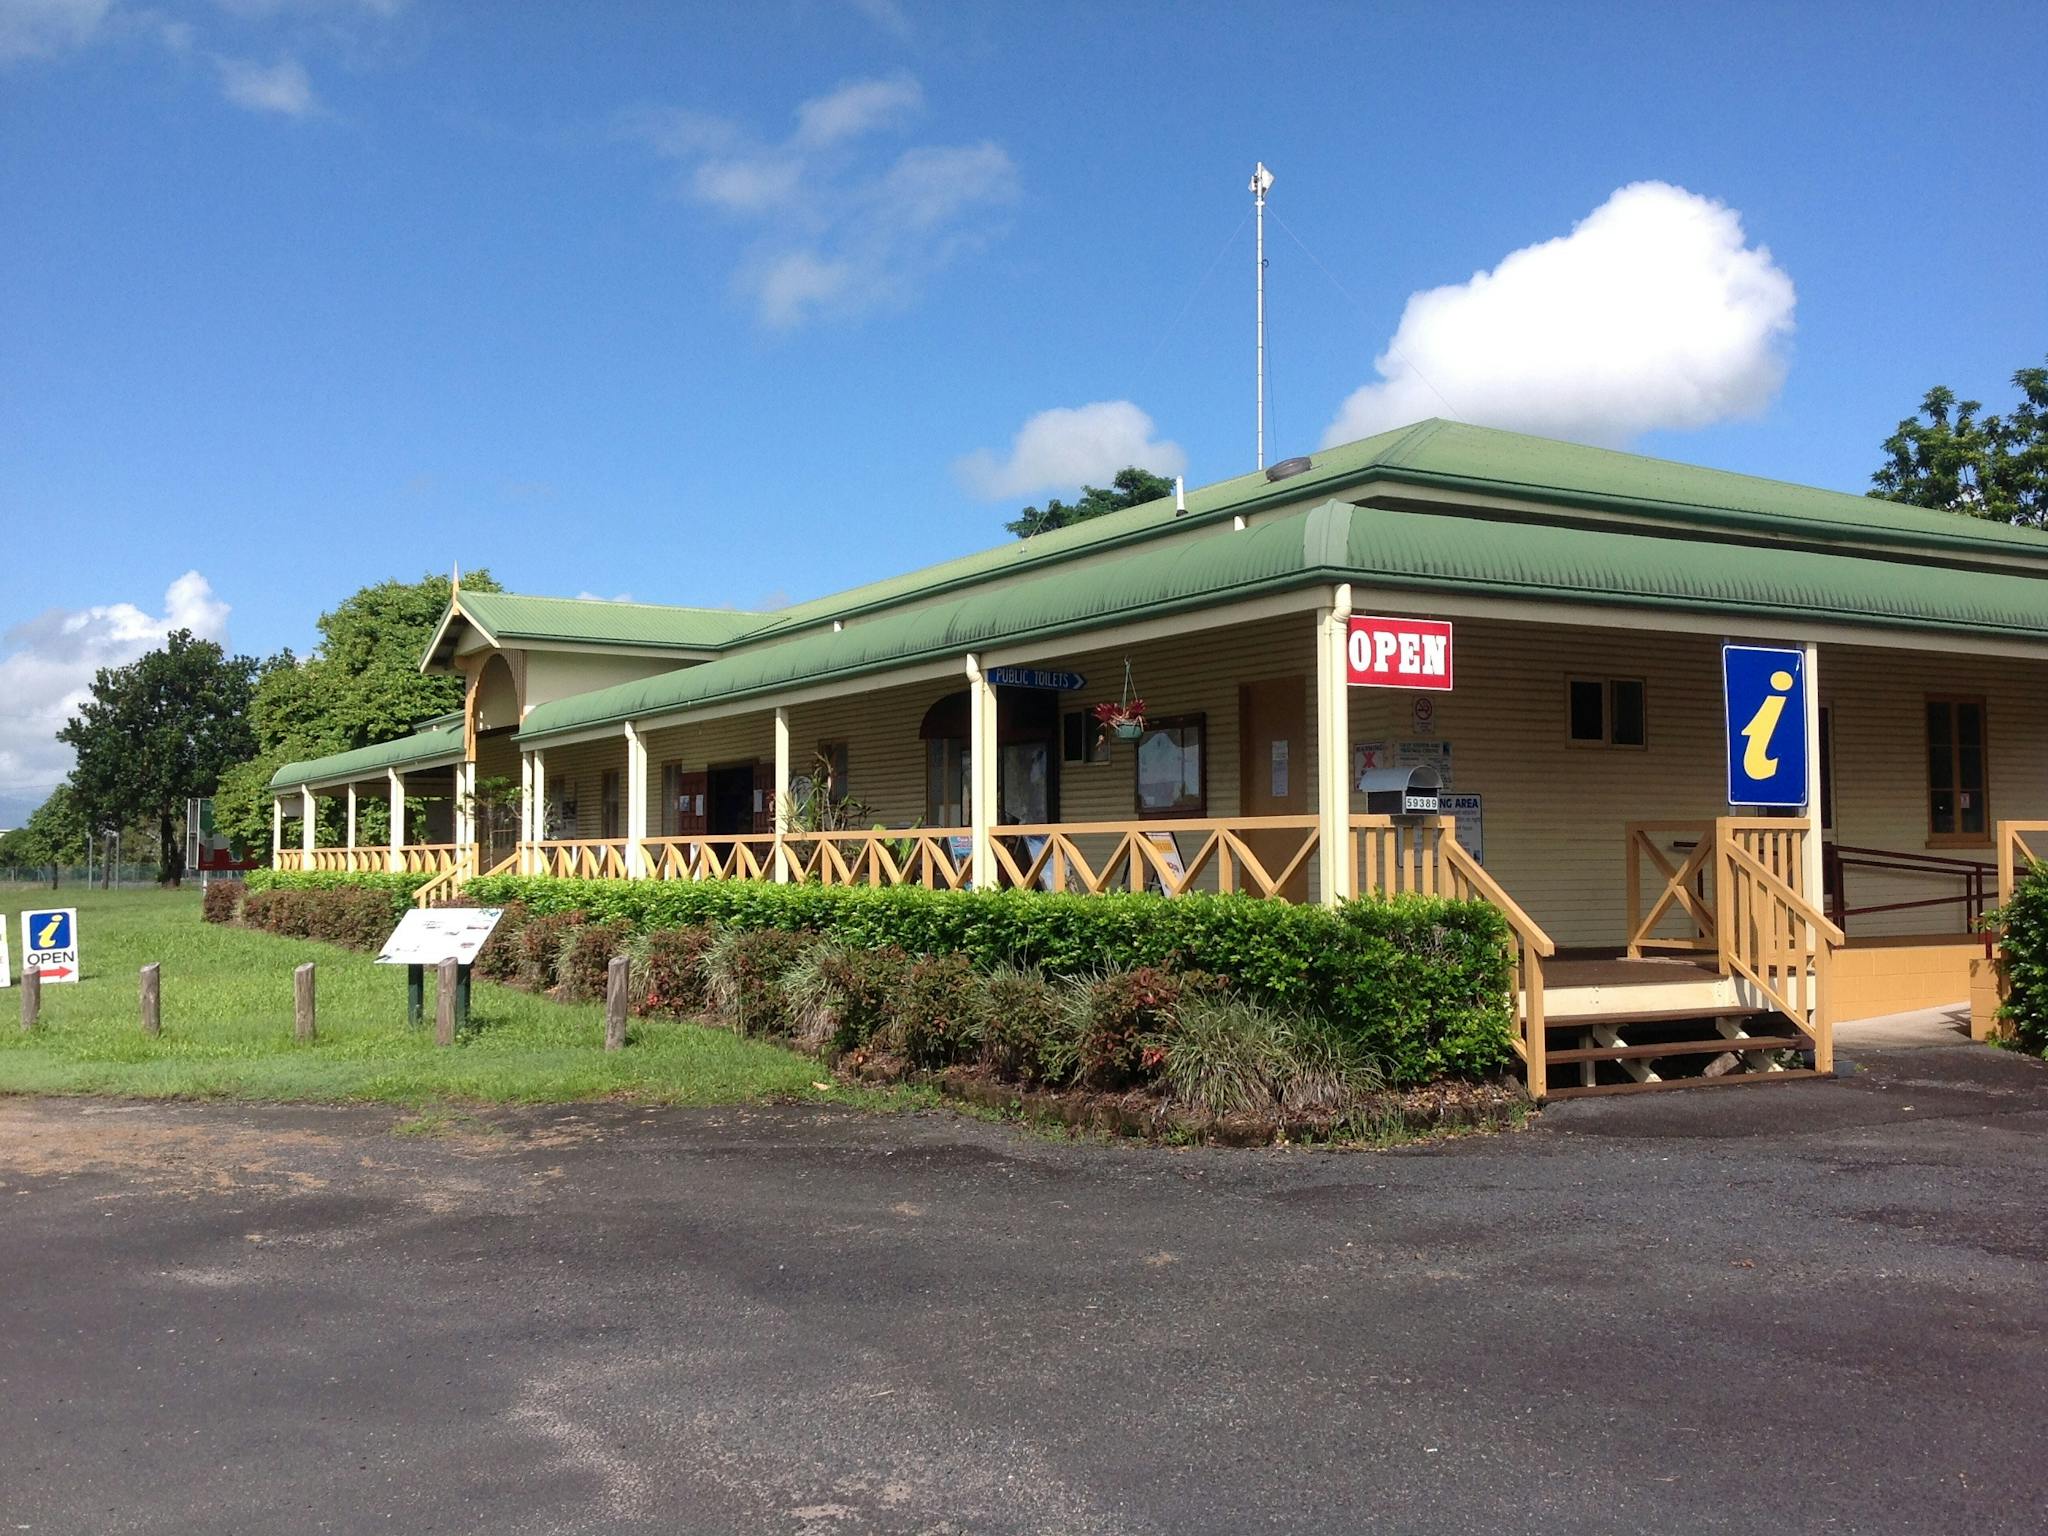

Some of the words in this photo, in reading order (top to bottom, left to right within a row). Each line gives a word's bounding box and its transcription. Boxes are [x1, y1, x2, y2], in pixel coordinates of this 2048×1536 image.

[1349, 629, 1447, 676] OPEN
[995, 668, 1028, 685] PUBLIC
[1034, 671, 1069, 688] TOILETS
[1407, 798, 1437, 808] 59389
[1455, 798, 1479, 809] AREA
[27, 951, 75, 965] OPEN
